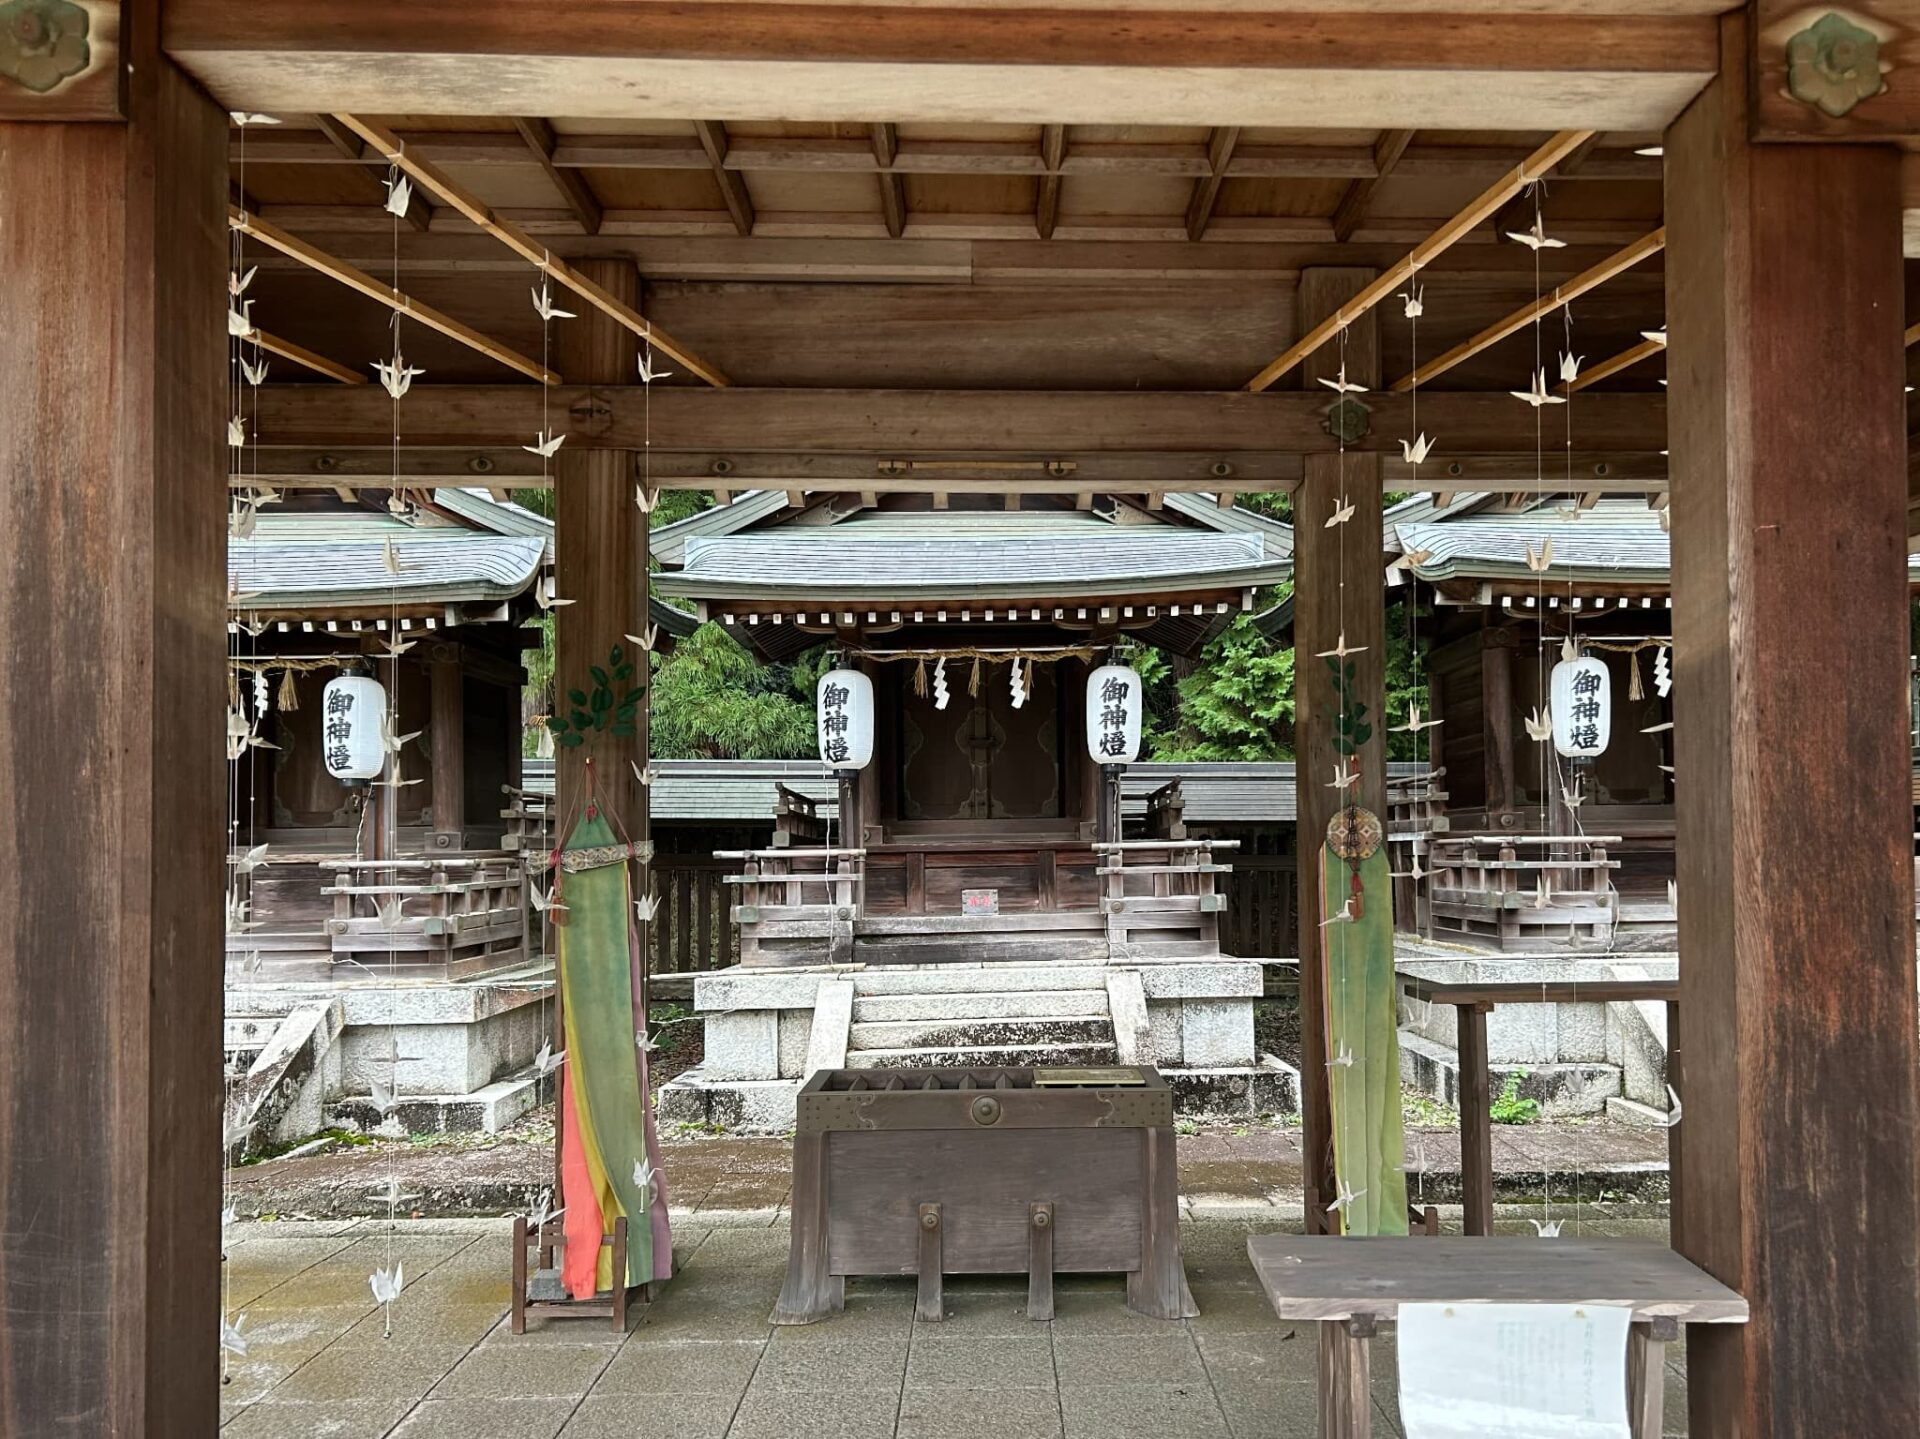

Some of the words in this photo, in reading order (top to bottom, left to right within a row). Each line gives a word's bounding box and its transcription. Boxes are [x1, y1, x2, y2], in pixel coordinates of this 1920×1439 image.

[327, 688, 354, 771] 御神燈
[823, 682, 851, 763] 御神燈
[1099, 676, 1129, 757] 御神燈
[1570, 669, 1601, 749] 御神燈
